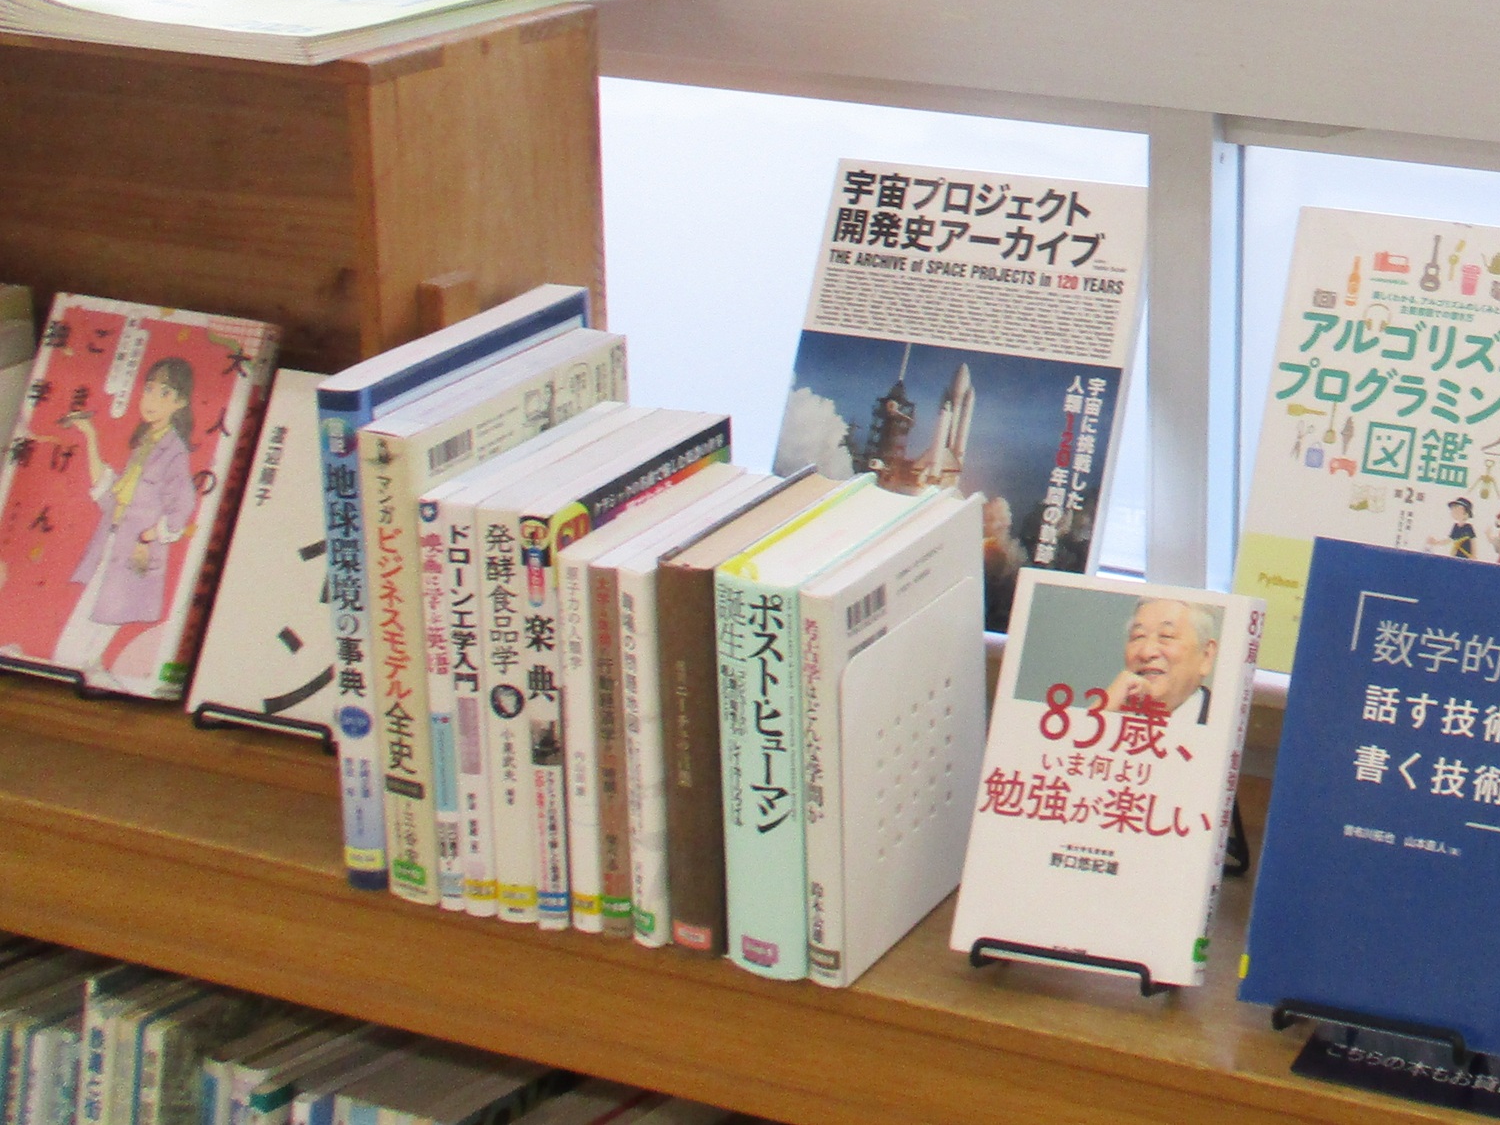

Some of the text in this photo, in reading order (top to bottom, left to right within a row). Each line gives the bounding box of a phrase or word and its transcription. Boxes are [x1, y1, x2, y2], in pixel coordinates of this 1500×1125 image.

[842, 170, 1091, 228] 宇宙プロジェクト
[829, 249, 852, 266] THE
[854, 252, 907, 273] ARCHIVE
[910, 258, 924, 273] of
[926, 260, 968, 279] SPACE
[970, 264, 1036, 287] PROJECTS
[1056, 273, 1079, 291] 120
[1082, 277, 1125, 296] YEARS
[832, 206, 1107, 268] 開発史アーカイブ
[1361, 421, 1475, 488] 図鑑
[325, 463, 367, 699] 地球環境の事典
[449, 525, 480, 693] ドローン工学入門
[485, 524, 520, 675] 発酵食品学
[524, 614, 560, 702] 楽典
[1039, 683, 1194, 762] 83歳、
[978, 766, 1213, 838] 勉強が楽しい
[1041, 752, 1153, 786] いま何より
